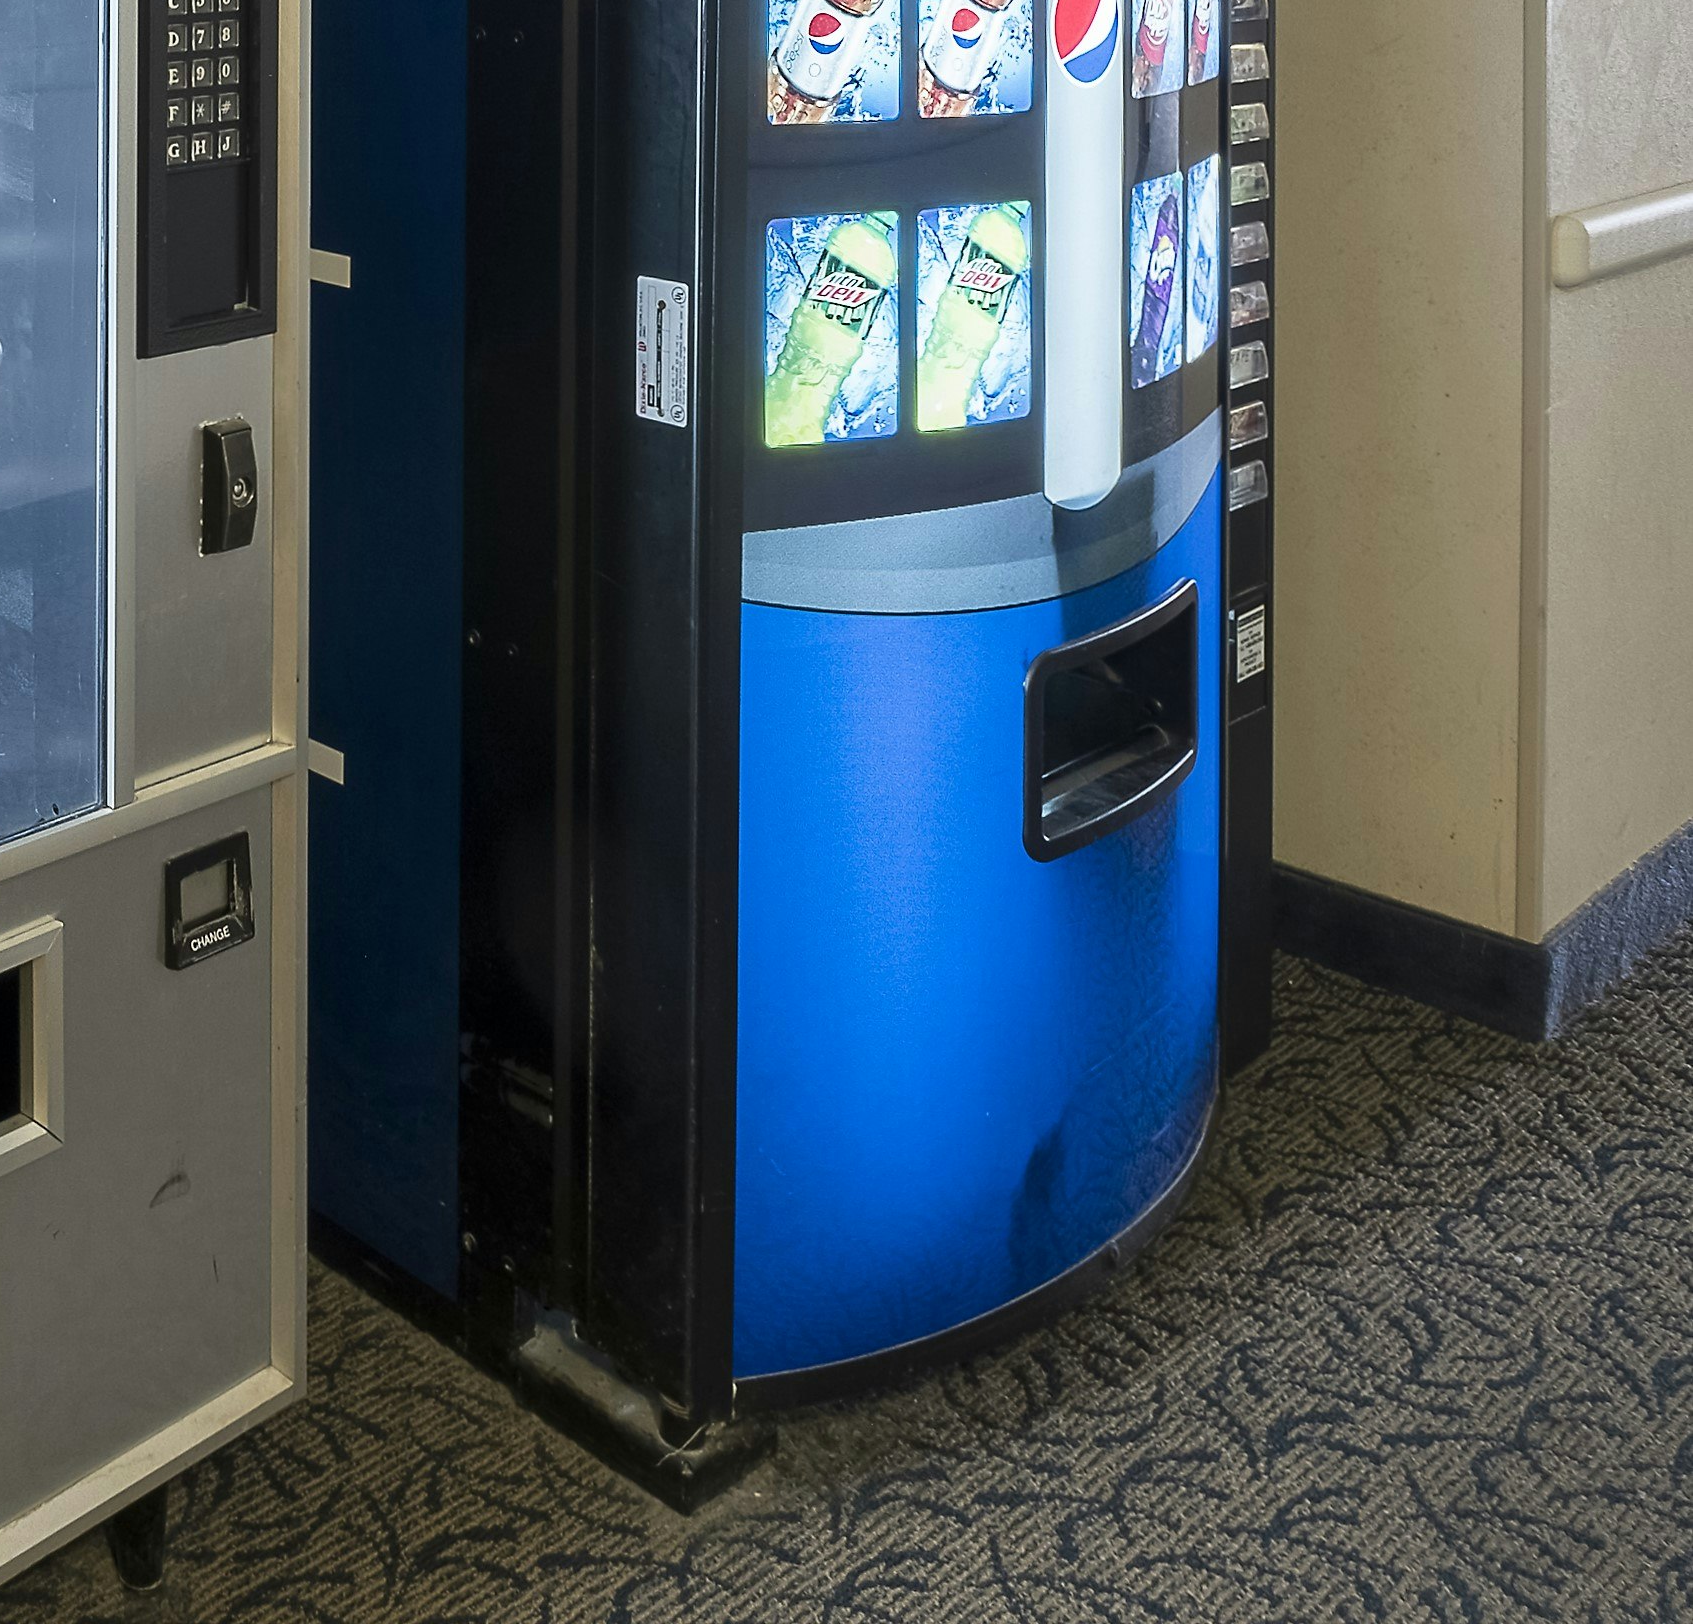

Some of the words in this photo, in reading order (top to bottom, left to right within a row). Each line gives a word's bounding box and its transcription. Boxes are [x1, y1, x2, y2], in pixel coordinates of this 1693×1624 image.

[168, 32, 179, 47] D
[196, 29, 205, 44] 7
[222, 27, 230, 42] 8
[168, 69, 179, 84] E
[196, 66, 204, 81] 9
[222, 64, 230, 78] 0
[168, 106, 179, 122] F
[168, 143, 180, 159] G
[194, 139, 206, 156] H
[222, 135, 231, 151] J
[190, 925, 231, 952] CHANGE
